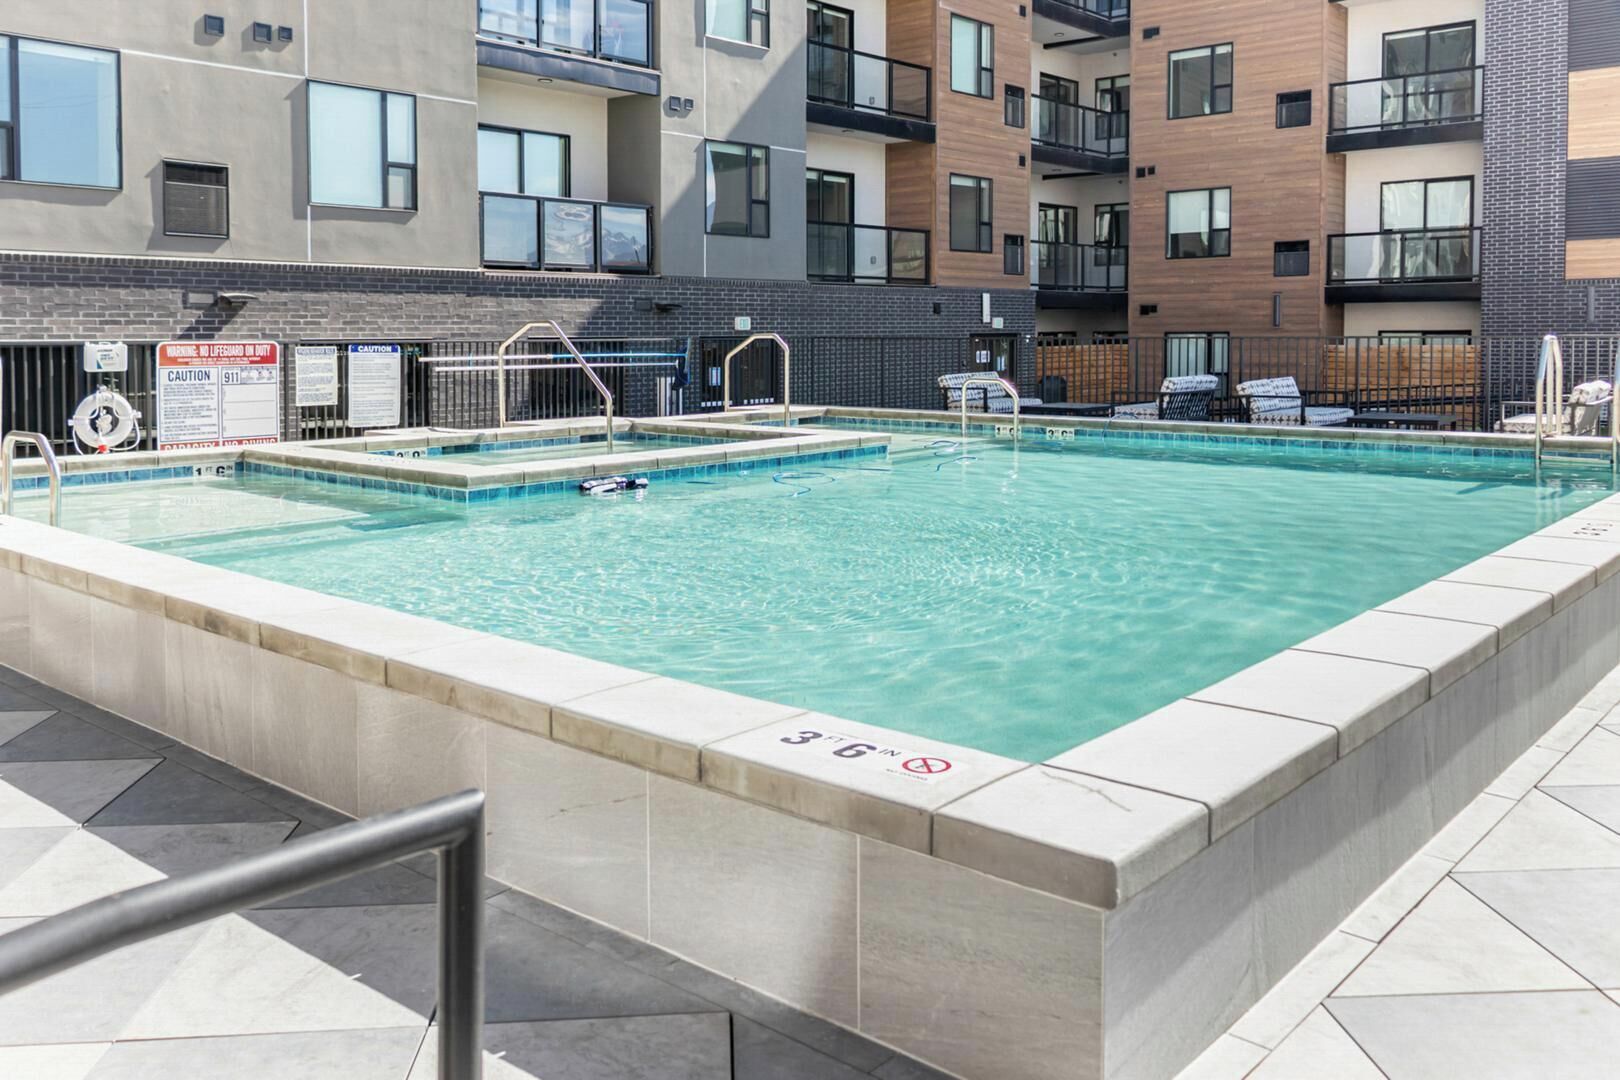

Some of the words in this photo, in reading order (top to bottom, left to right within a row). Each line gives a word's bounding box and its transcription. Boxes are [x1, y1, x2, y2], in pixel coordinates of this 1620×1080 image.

[166, 345, 198, 357] WARNING:
[200, 345, 209, 357] NO
[210, 345, 244, 357] LIFEGUARD
[245, 345, 254, 357] ON
[255, 344, 271, 357] DUTY
[168, 370, 211, 382] CAUTION
[224, 372, 239, 383] 911
[780, 731, 823, 744] 3
[823, 735, 847, 743] FT
[832, 743, 877, 758] 6
[878, 748, 902, 757] IN
